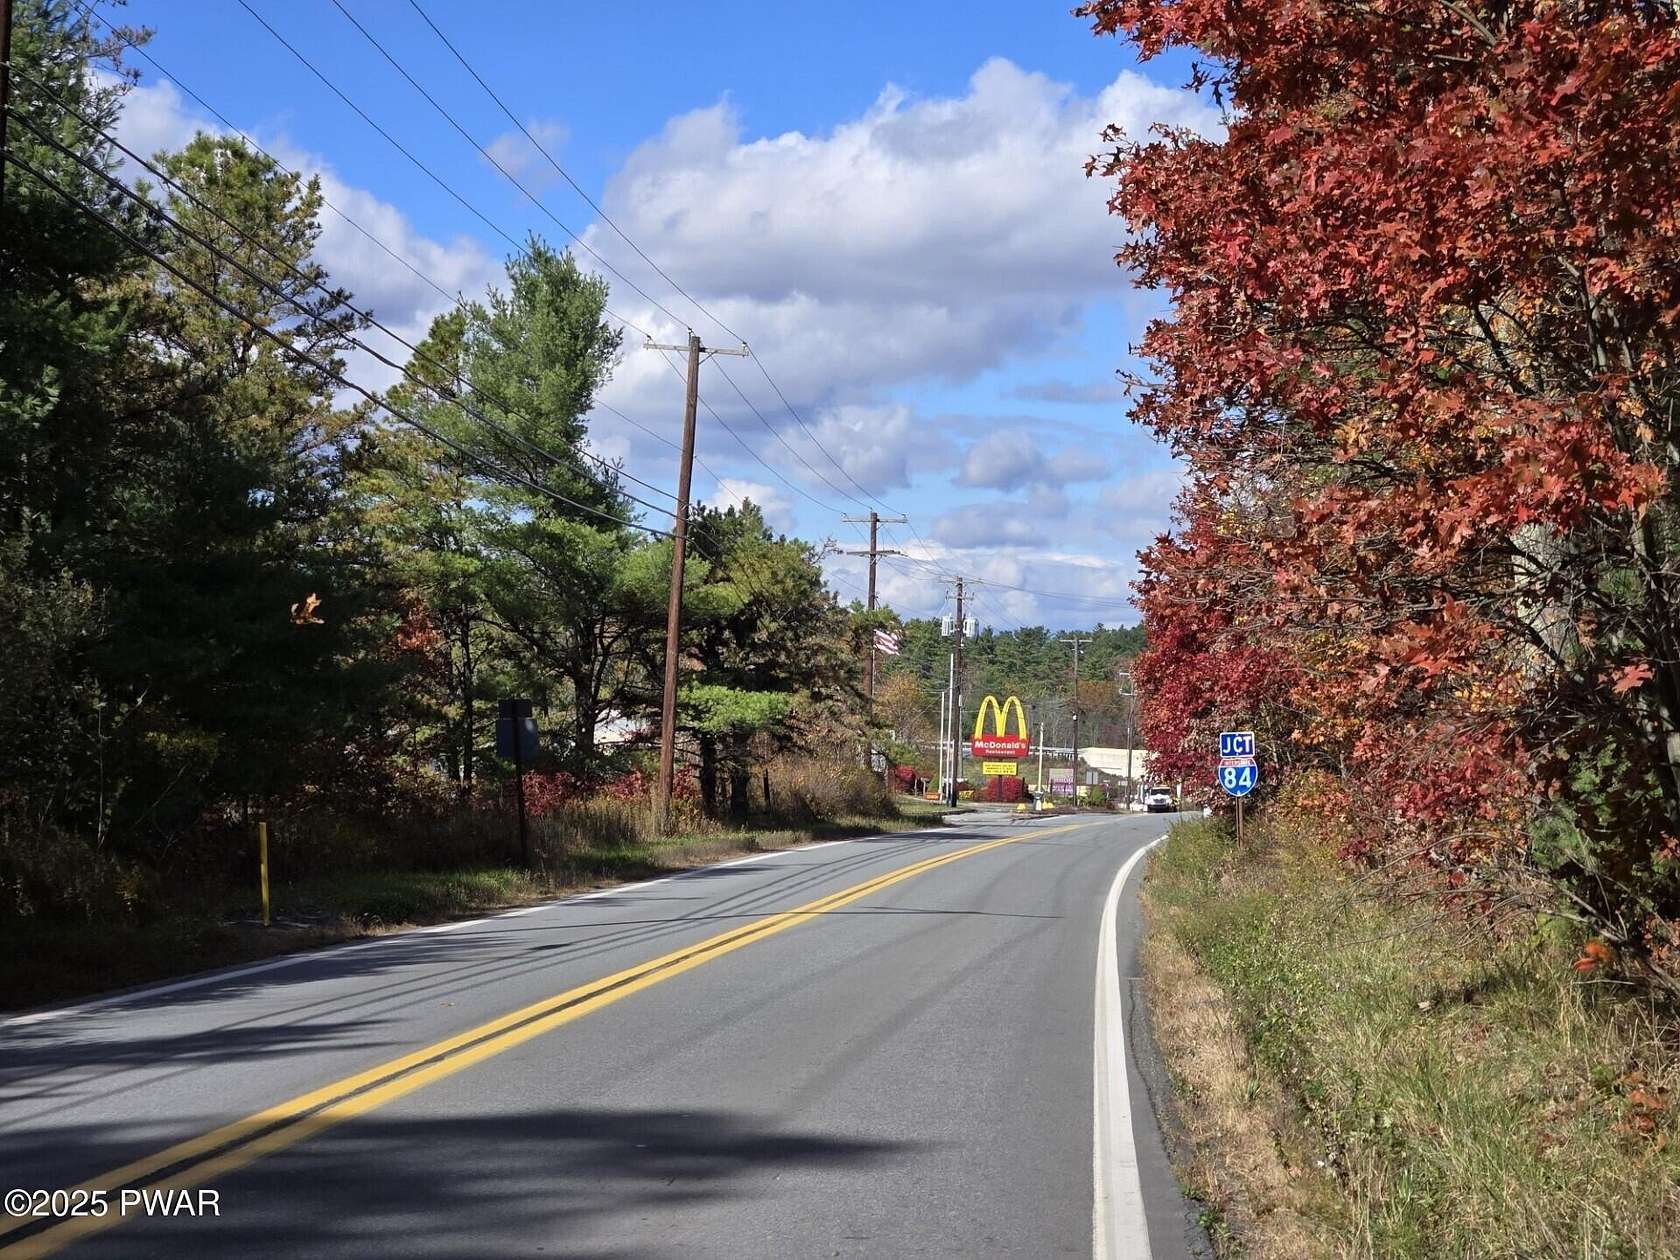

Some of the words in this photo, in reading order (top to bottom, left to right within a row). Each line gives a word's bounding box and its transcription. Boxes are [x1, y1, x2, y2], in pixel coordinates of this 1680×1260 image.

[974, 741, 1026, 749] McDonald's
[1223, 736, 1252, 753] JCT
[1224, 767, 1252, 789] 84
